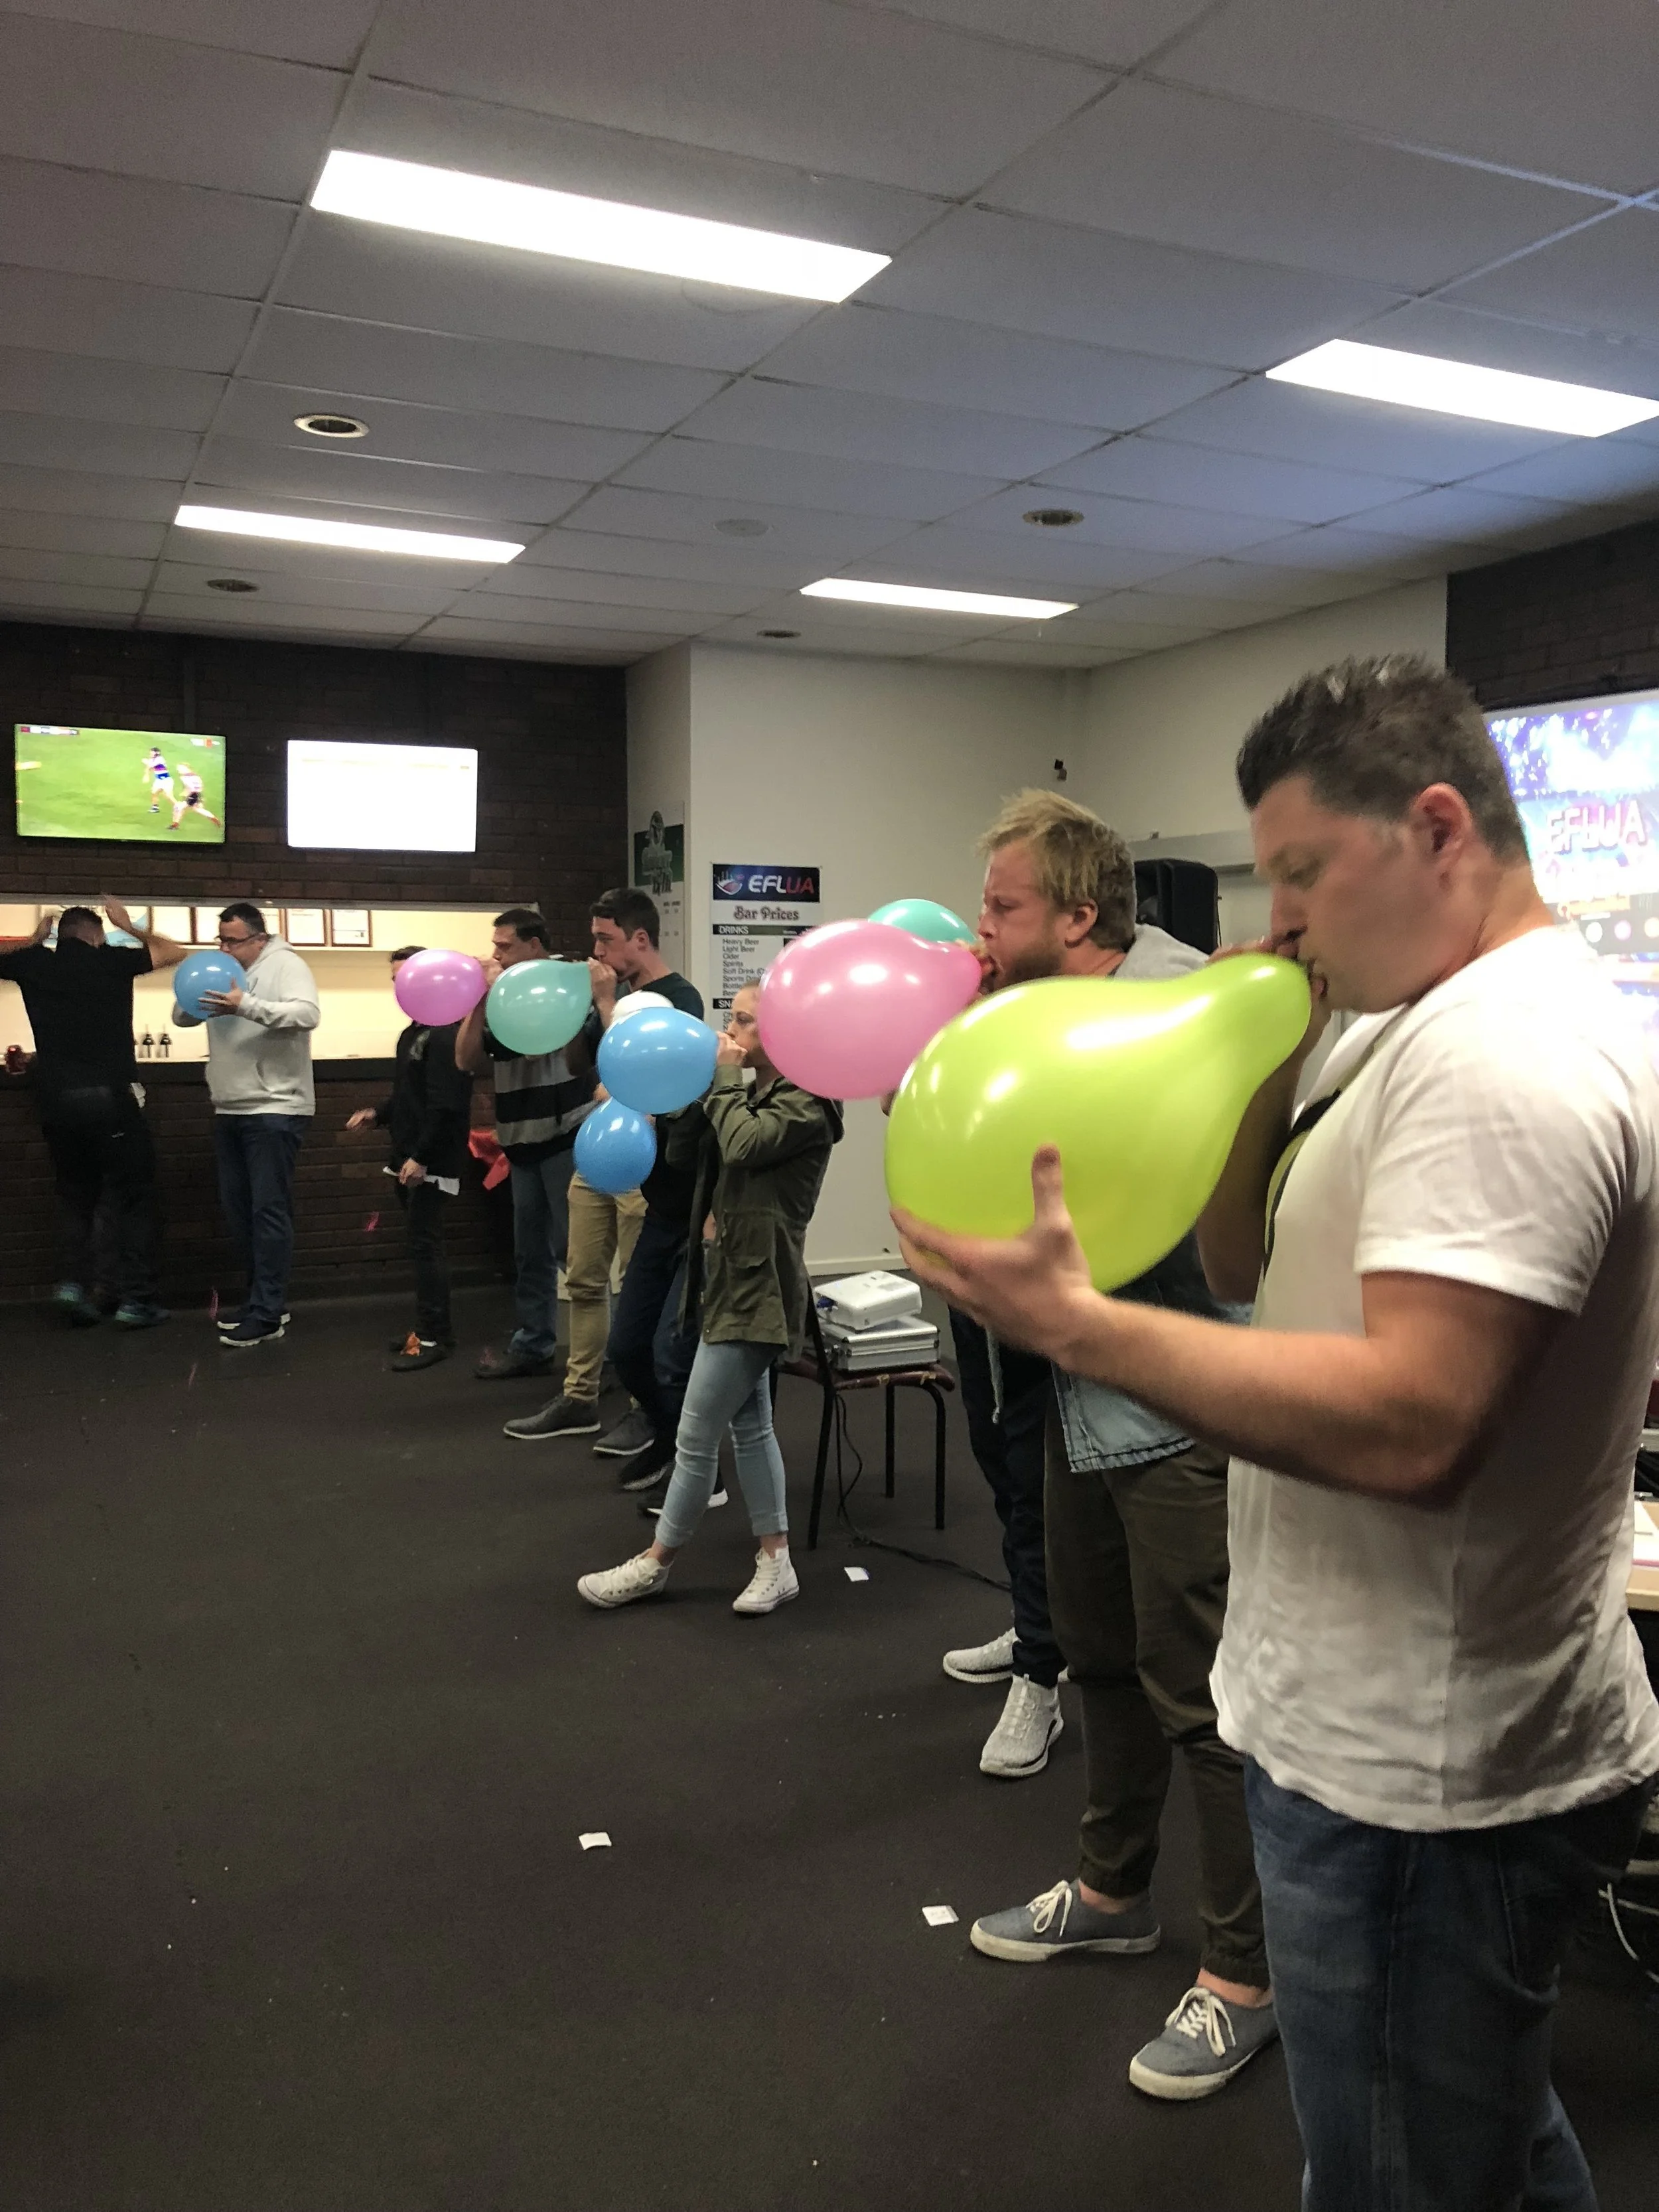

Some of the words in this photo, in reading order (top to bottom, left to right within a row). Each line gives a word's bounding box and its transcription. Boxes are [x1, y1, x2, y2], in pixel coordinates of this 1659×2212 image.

[748, 874, 815, 894] EFLUA
[733, 905, 758, 921] Bar
[760, 906, 800, 921] Prices
[719, 925, 749, 934] DRINKS
